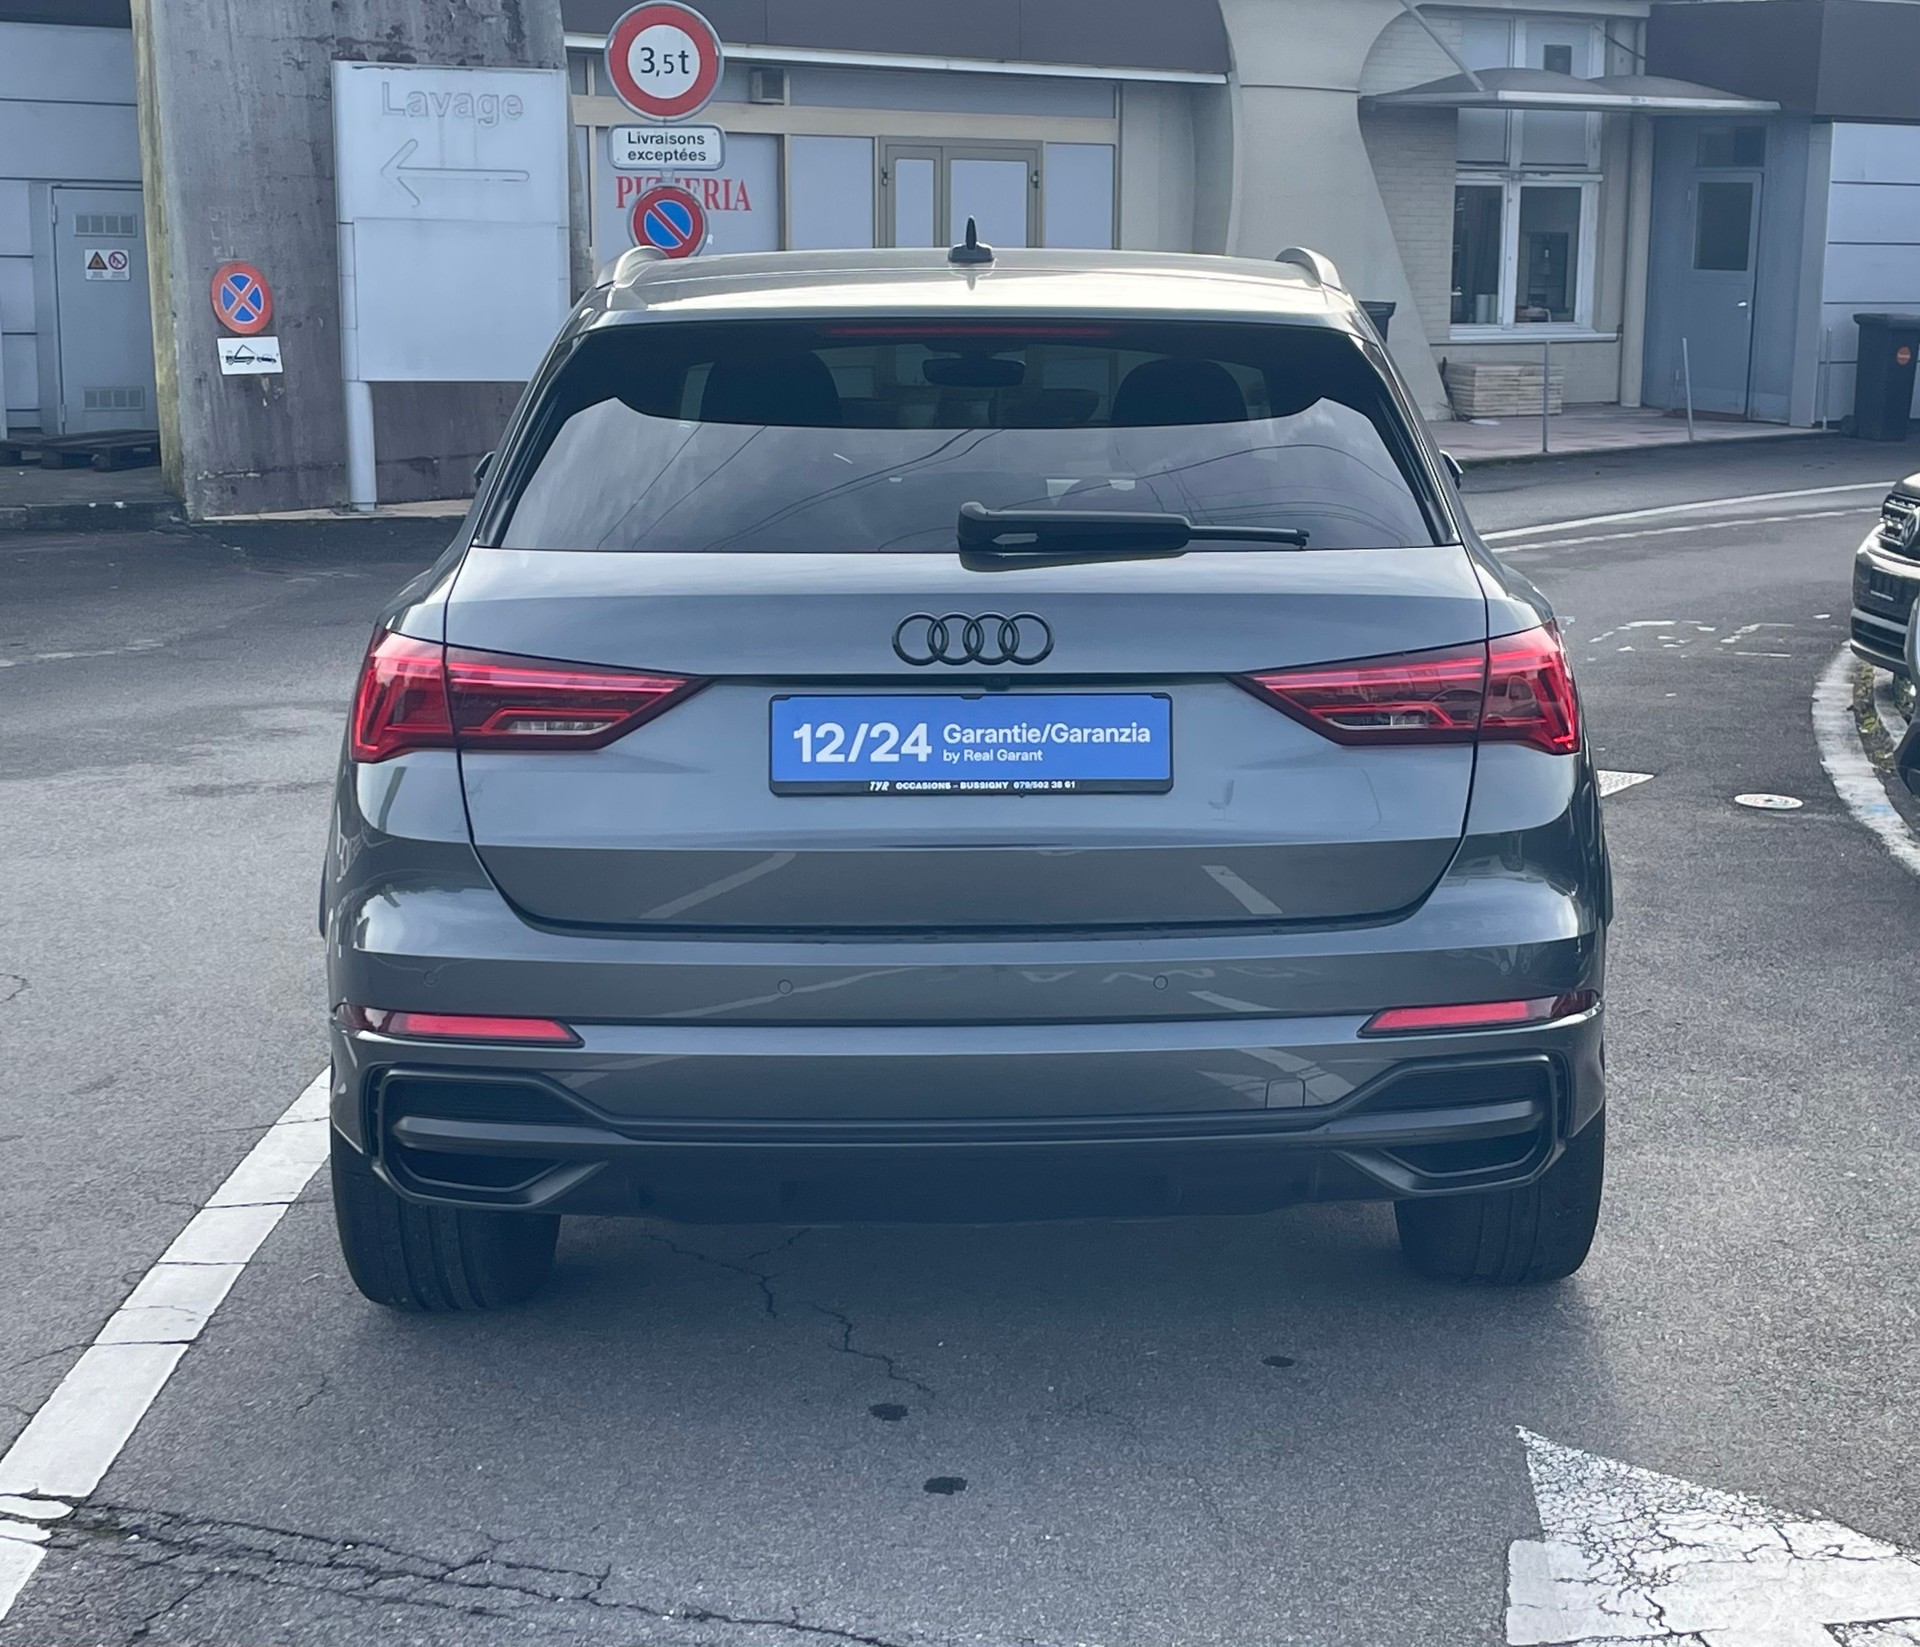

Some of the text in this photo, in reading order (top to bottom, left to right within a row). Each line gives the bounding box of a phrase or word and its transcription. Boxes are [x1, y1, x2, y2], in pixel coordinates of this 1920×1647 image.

[381, 81, 524, 128] Lavage
[627, 131, 705, 145] Livraisons
[627, 148, 707, 163] exceptées
[942, 722, 1151, 744] Garantie/Garanzia
[793, 721, 932, 763] 12/24
[942, 749, 1044, 765] by Real Garant
[869, 781, 889, 791] TYR
[895, 781, 952, 790] OCCASIONS
[960, 781, 1009, 790] BUSSIGNY
